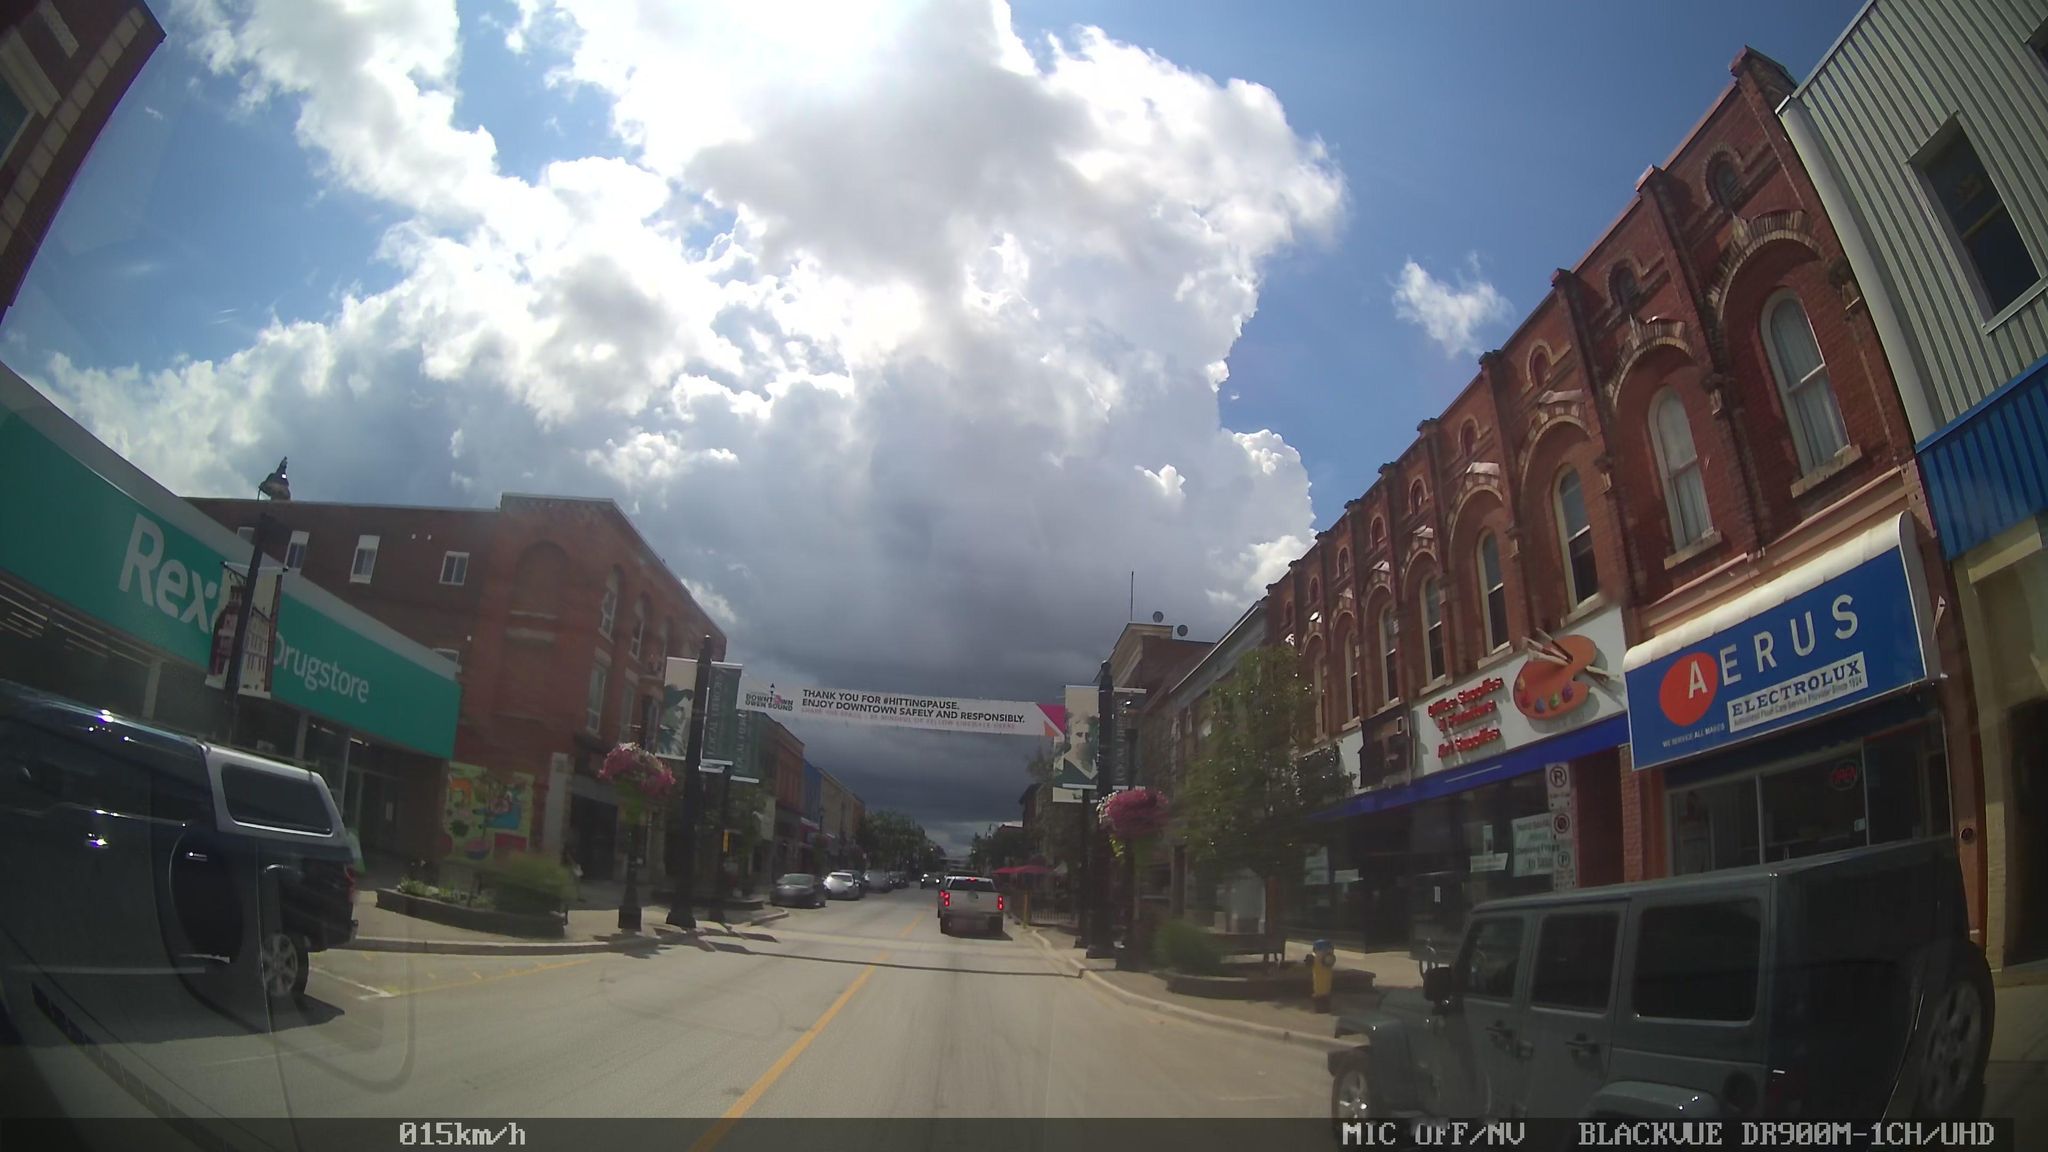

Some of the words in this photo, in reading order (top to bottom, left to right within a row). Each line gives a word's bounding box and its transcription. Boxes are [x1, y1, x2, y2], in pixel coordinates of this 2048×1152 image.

[1687, 594, 1858, 699] AERUS
[803, 689, 837, 700] THANK
[838, 692, 859, 702] YOU
[861, 694, 881, 704] FOR
[883, 696, 960, 710] #HITTINGPAUSE.
[1732, 660, 1862, 717] ELECTROLUX
[767, 702, 793, 712] SOUND
[802, 698, 835, 708] ENJOY
[839, 701, 897, 715] DOWNTOWN
[899, 707, 934, 718] SAFELY
[935, 710, 958, 720] AND
[960, 711, 1025, 724] RESPONSIBLY.
